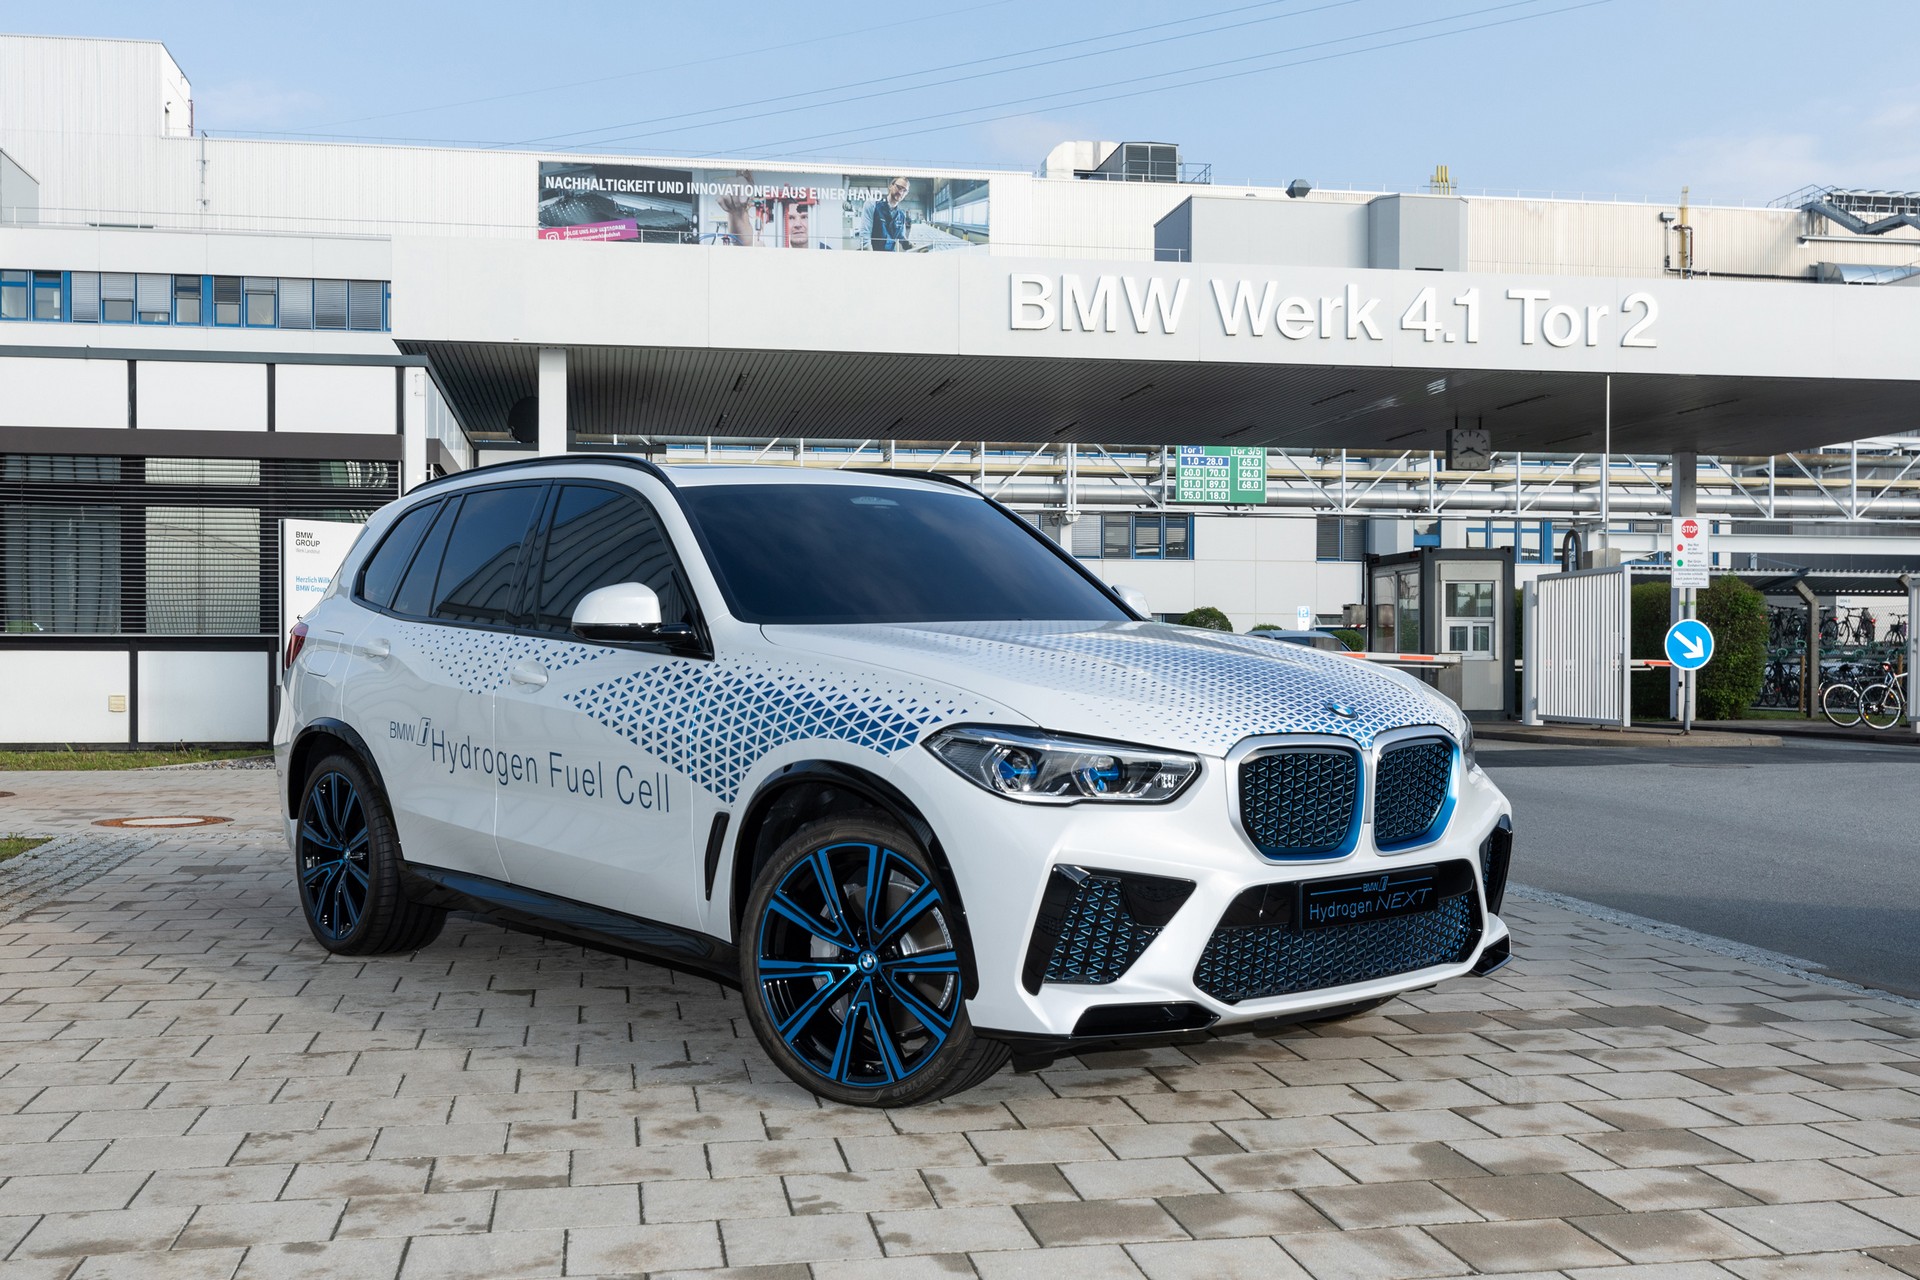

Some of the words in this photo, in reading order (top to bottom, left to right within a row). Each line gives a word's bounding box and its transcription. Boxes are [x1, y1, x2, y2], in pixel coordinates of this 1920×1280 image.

[545, 176, 655, 193] NACHHALTIGKEIT
[658, 181, 684, 195] UND
[687, 182, 779, 199] INNOVATIONEN
[781, 187, 807, 199] AUS
[810, 188, 845, 201] EINER
[849, 189, 887, 202] HAND.
[1009, 273, 1190, 334] BMW
[1210, 279, 1384, 342] Werk
[1401, 286, 1479, 344] 4.1
[1507, 288, 1609, 348] Tor
[1620, 292, 1659, 349] 2
[1182, 446, 1197, 454] Tor
[1233, 447, 1246, 455] Tor
[1248, 447, 1261, 456] 3/5
[1187, 458, 1199, 466] 1.0
[1206, 458, 1223, 466] 28.0
[1209, 469, 1226, 477] 70.0
[1242, 470, 1259, 478] 66.0
[1184, 480, 1201, 488] 81.0
[1209, 480, 1226, 488] 89.0
[1242, 481, 1259, 489] 68.0
[1210, 492, 1226, 500] 18.0
[295, 531, 314, 539] BMW
[295, 539, 321, 547] GROUP
[295, 576, 317, 584] Herzlich
[389, 721, 416, 742] BMW
[431, 728, 538, 786] Hydrogen
[549, 751, 603, 798] Fuel
[616, 765, 670, 813] Cell
[1362, 881, 1379, 893] BMW
[1309, 900, 1373, 922] Hydrogen
[1376, 887, 1433, 911] NEXT
